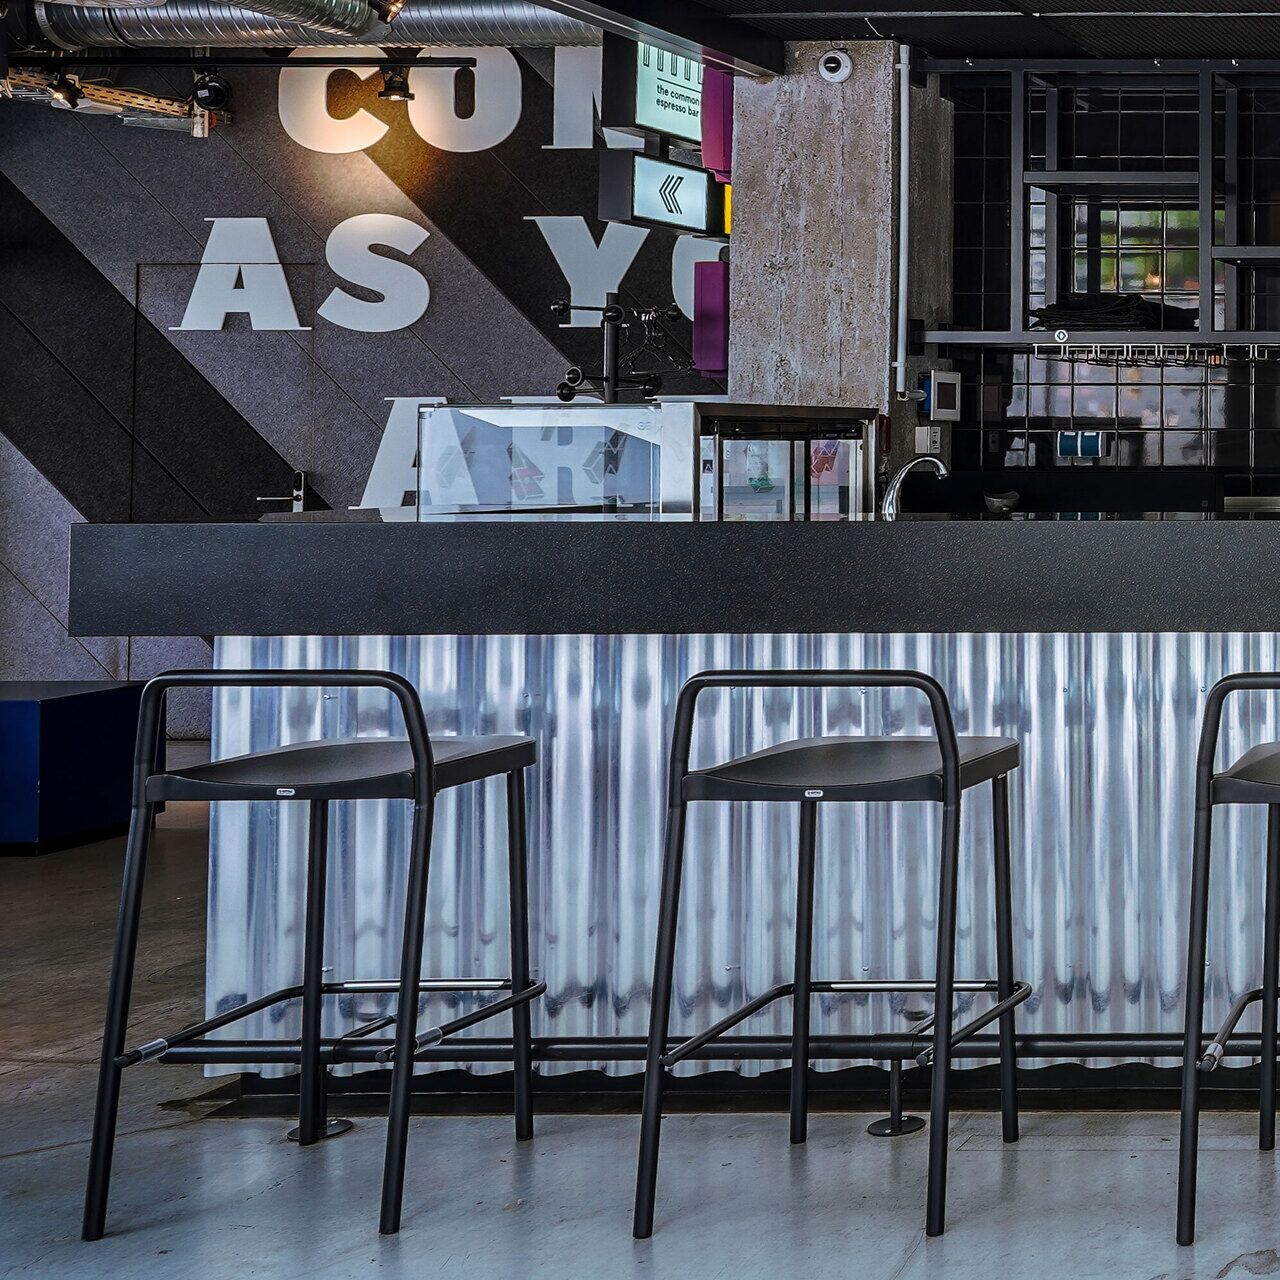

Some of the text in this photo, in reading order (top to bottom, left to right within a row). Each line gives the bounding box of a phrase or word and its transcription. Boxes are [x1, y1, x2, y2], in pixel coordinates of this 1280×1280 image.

[657, 84, 668, 96] the
[656, 98, 699, 117] espresso bar
[169, 213, 430, 334] AS
